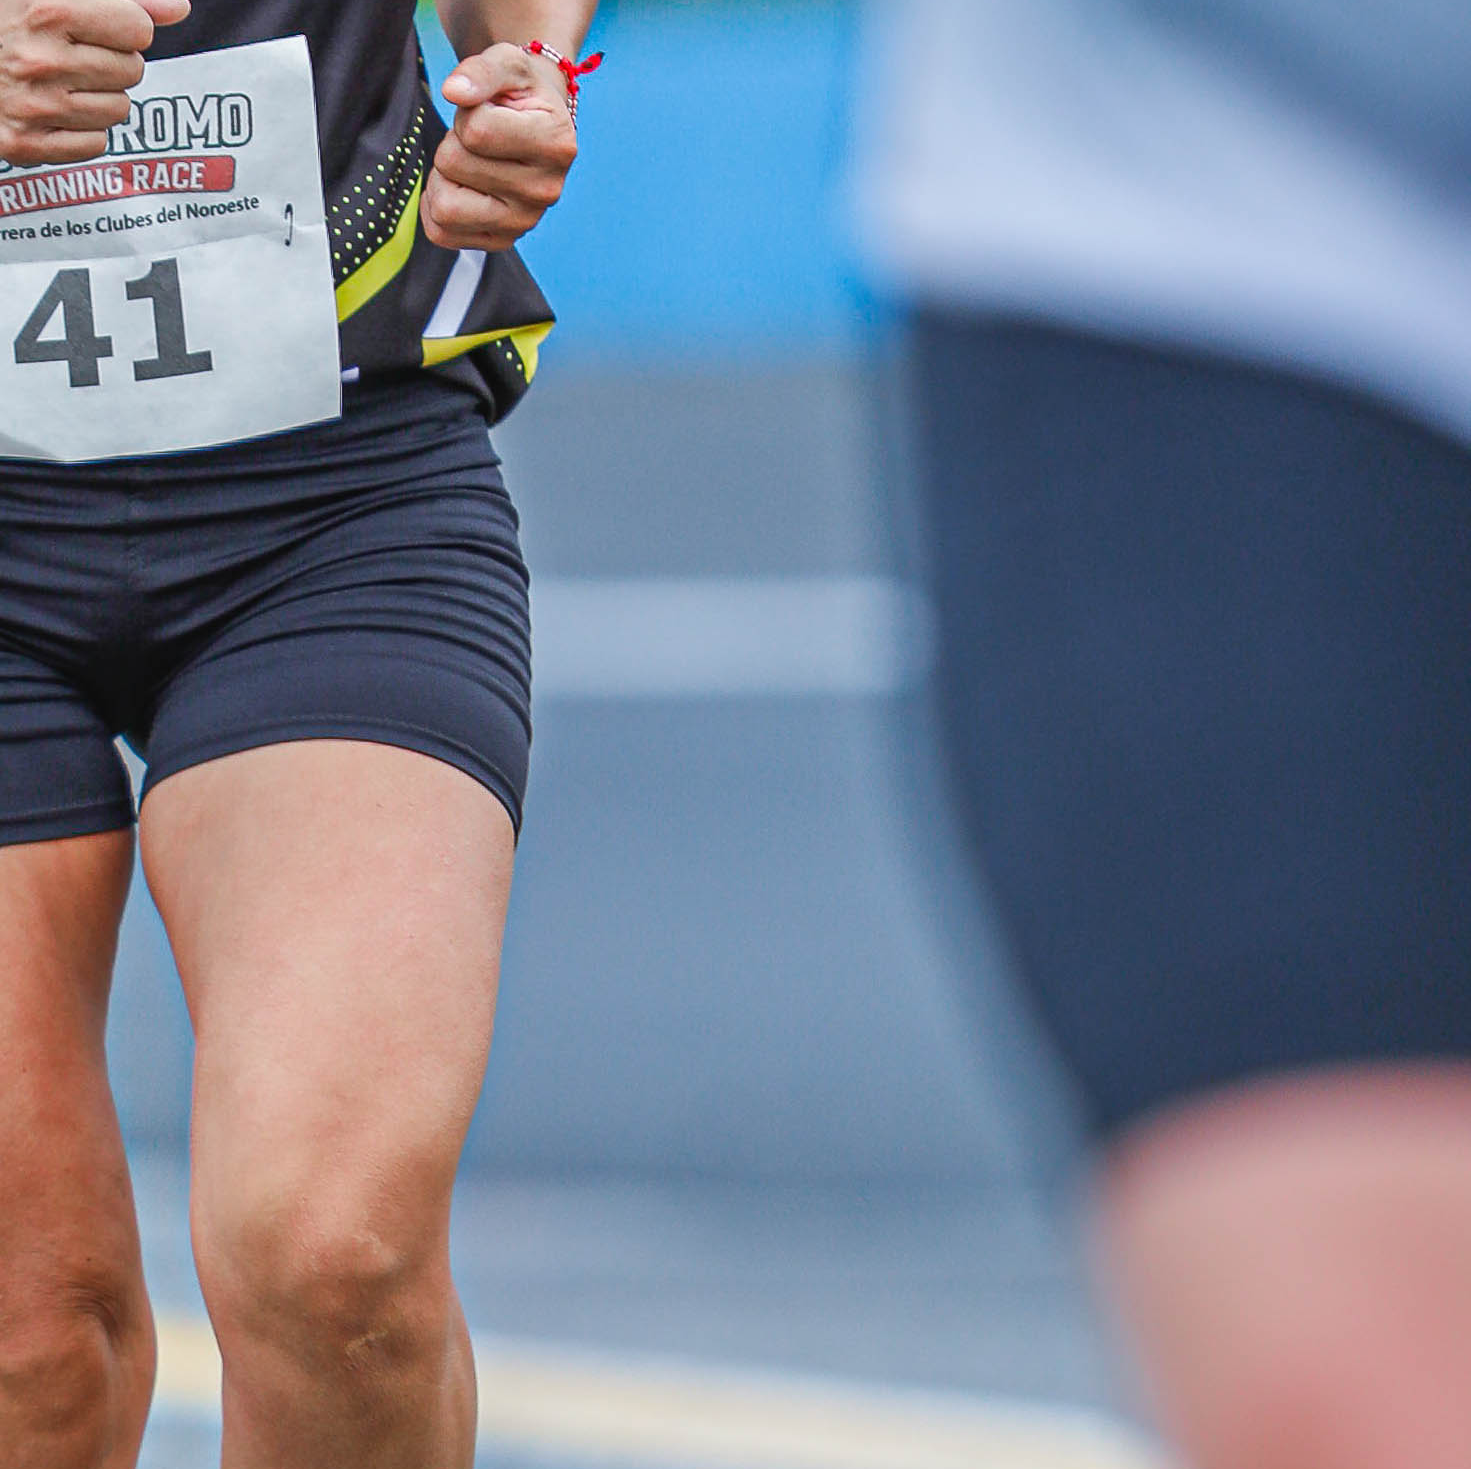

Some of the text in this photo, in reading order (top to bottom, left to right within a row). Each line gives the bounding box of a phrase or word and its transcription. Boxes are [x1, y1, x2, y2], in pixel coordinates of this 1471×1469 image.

[132, 161, 207, 193] RACE
[41, 221, 63, 238] de
[67, 219, 92, 236] los
[95, 212, 154, 233] Clubes
[157, 207, 182, 225] del
[185, 195, 261, 219] Noroeste
[12, 256, 215, 389] 41
